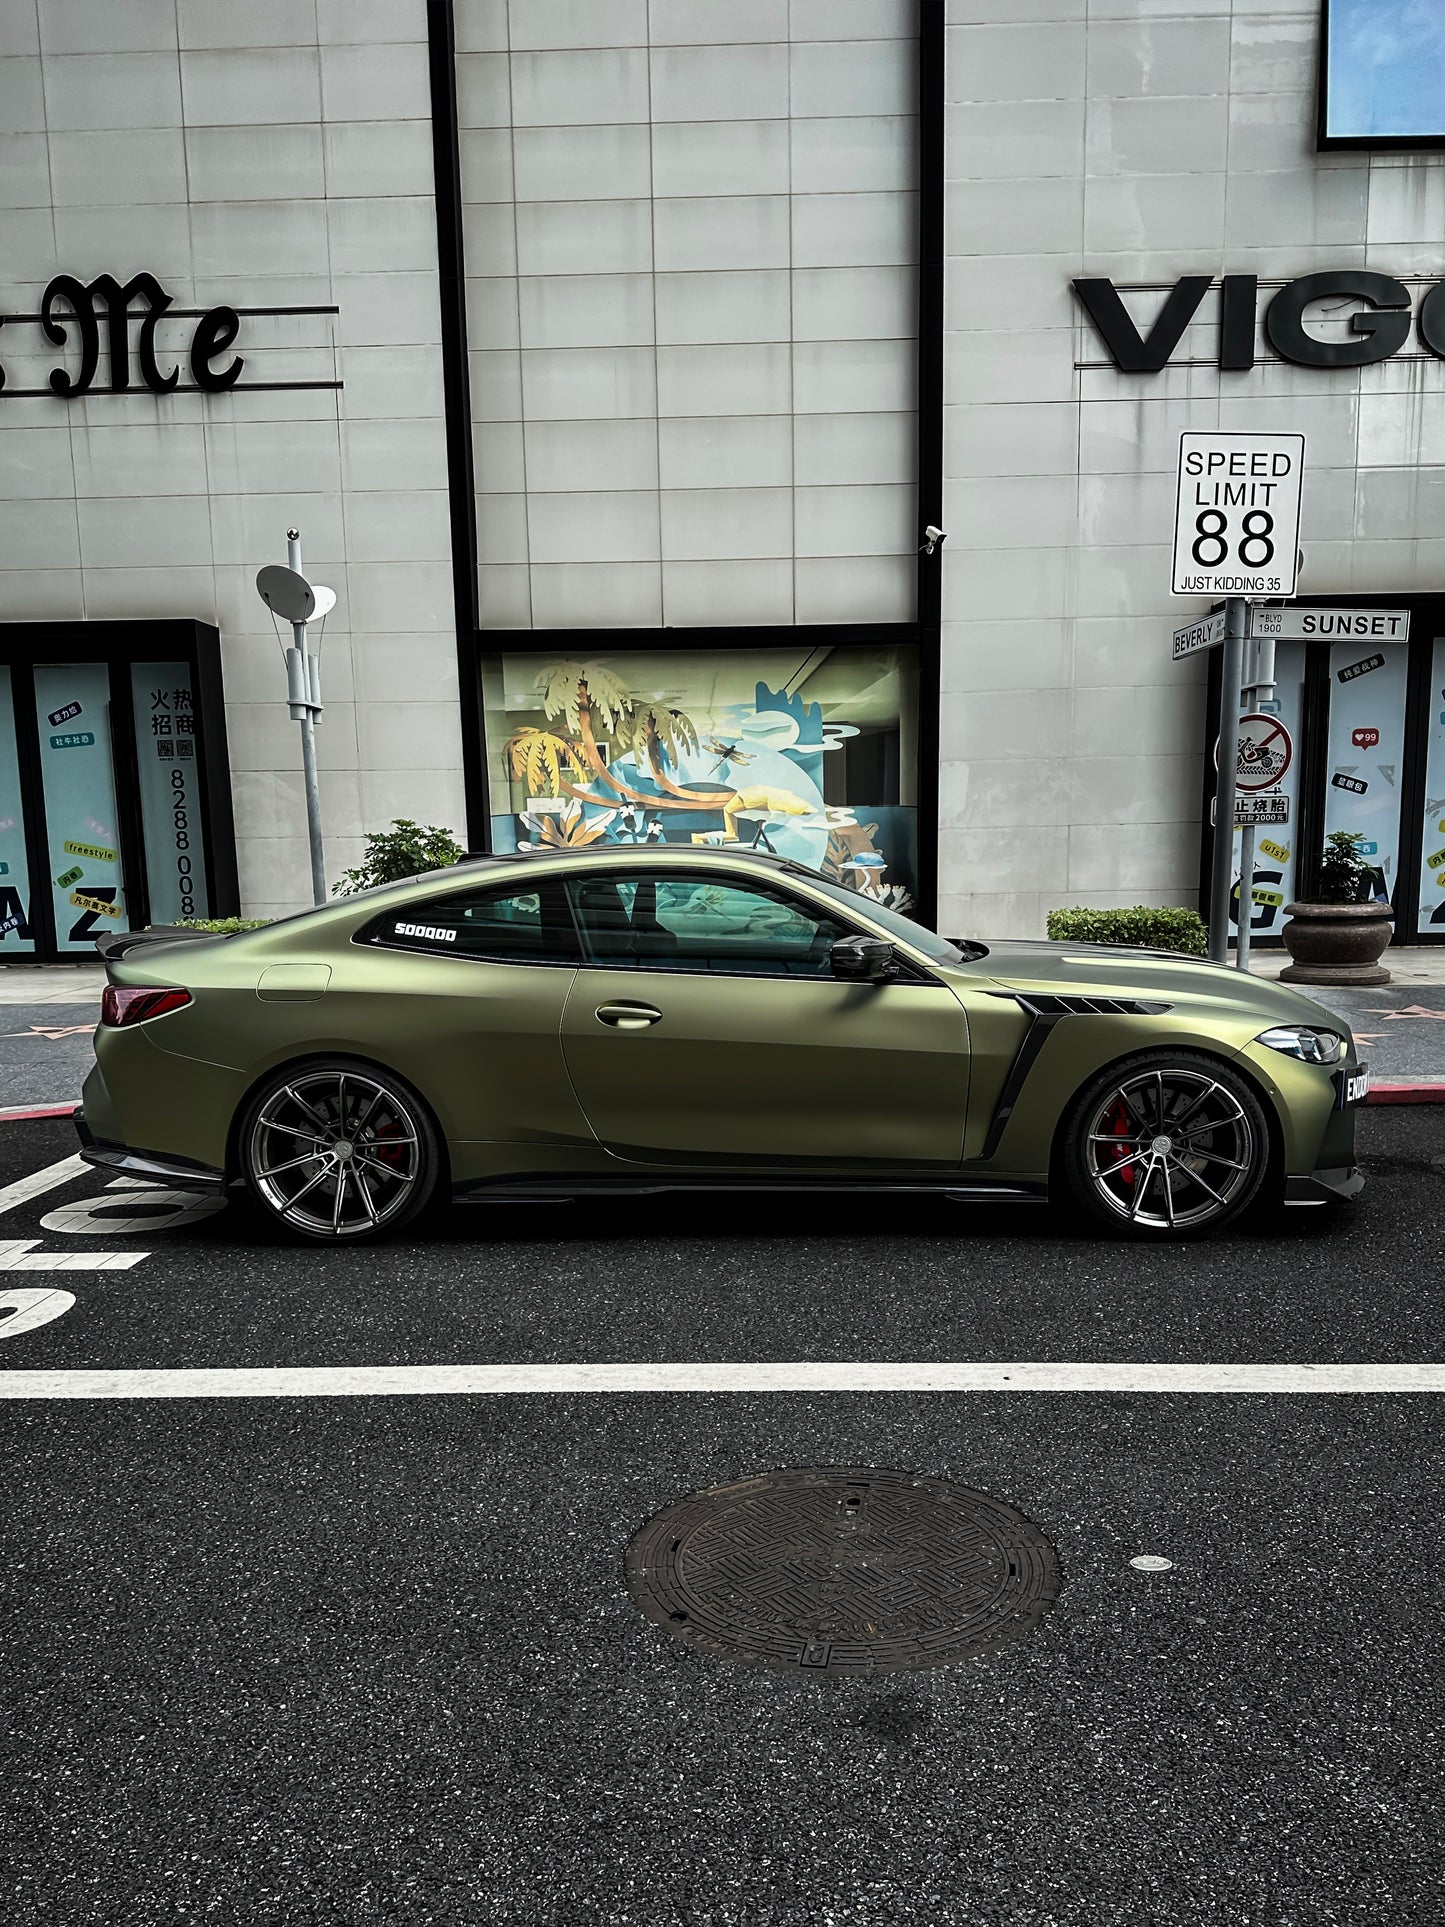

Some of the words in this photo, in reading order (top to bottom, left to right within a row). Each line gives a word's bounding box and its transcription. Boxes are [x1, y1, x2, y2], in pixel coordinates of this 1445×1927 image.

[1071, 270, 1445, 372] VIG
[41, 270, 245, 397] Me
[1185, 451, 1292, 477] SPEED
[1195, 482, 1278, 507] LIMIT
[1191, 508, 1275, 568] 88
[1181, 576, 1212, 591] JUST
[1214, 576, 1265, 591] KIDDING
[1267, 577, 1281, 591] 35
[1259, 623, 1282, 633] 1900
[1302, 614, 1402, 636] SUNSET
[1175, 623, 1213, 654] BEVERLY
[150, 688, 194, 711] 火热
[151, 714, 196, 735] 招商
[1364, 733, 1377, 741] 99
[1234, 798, 1285, 813] 止烧胎
[69, 843, 113, 860] freestyle
[1264, 844, 1285, 859] u1s1
[69, 887, 118, 942] Z
[74, 895, 118, 915] 凡尔赛文学
